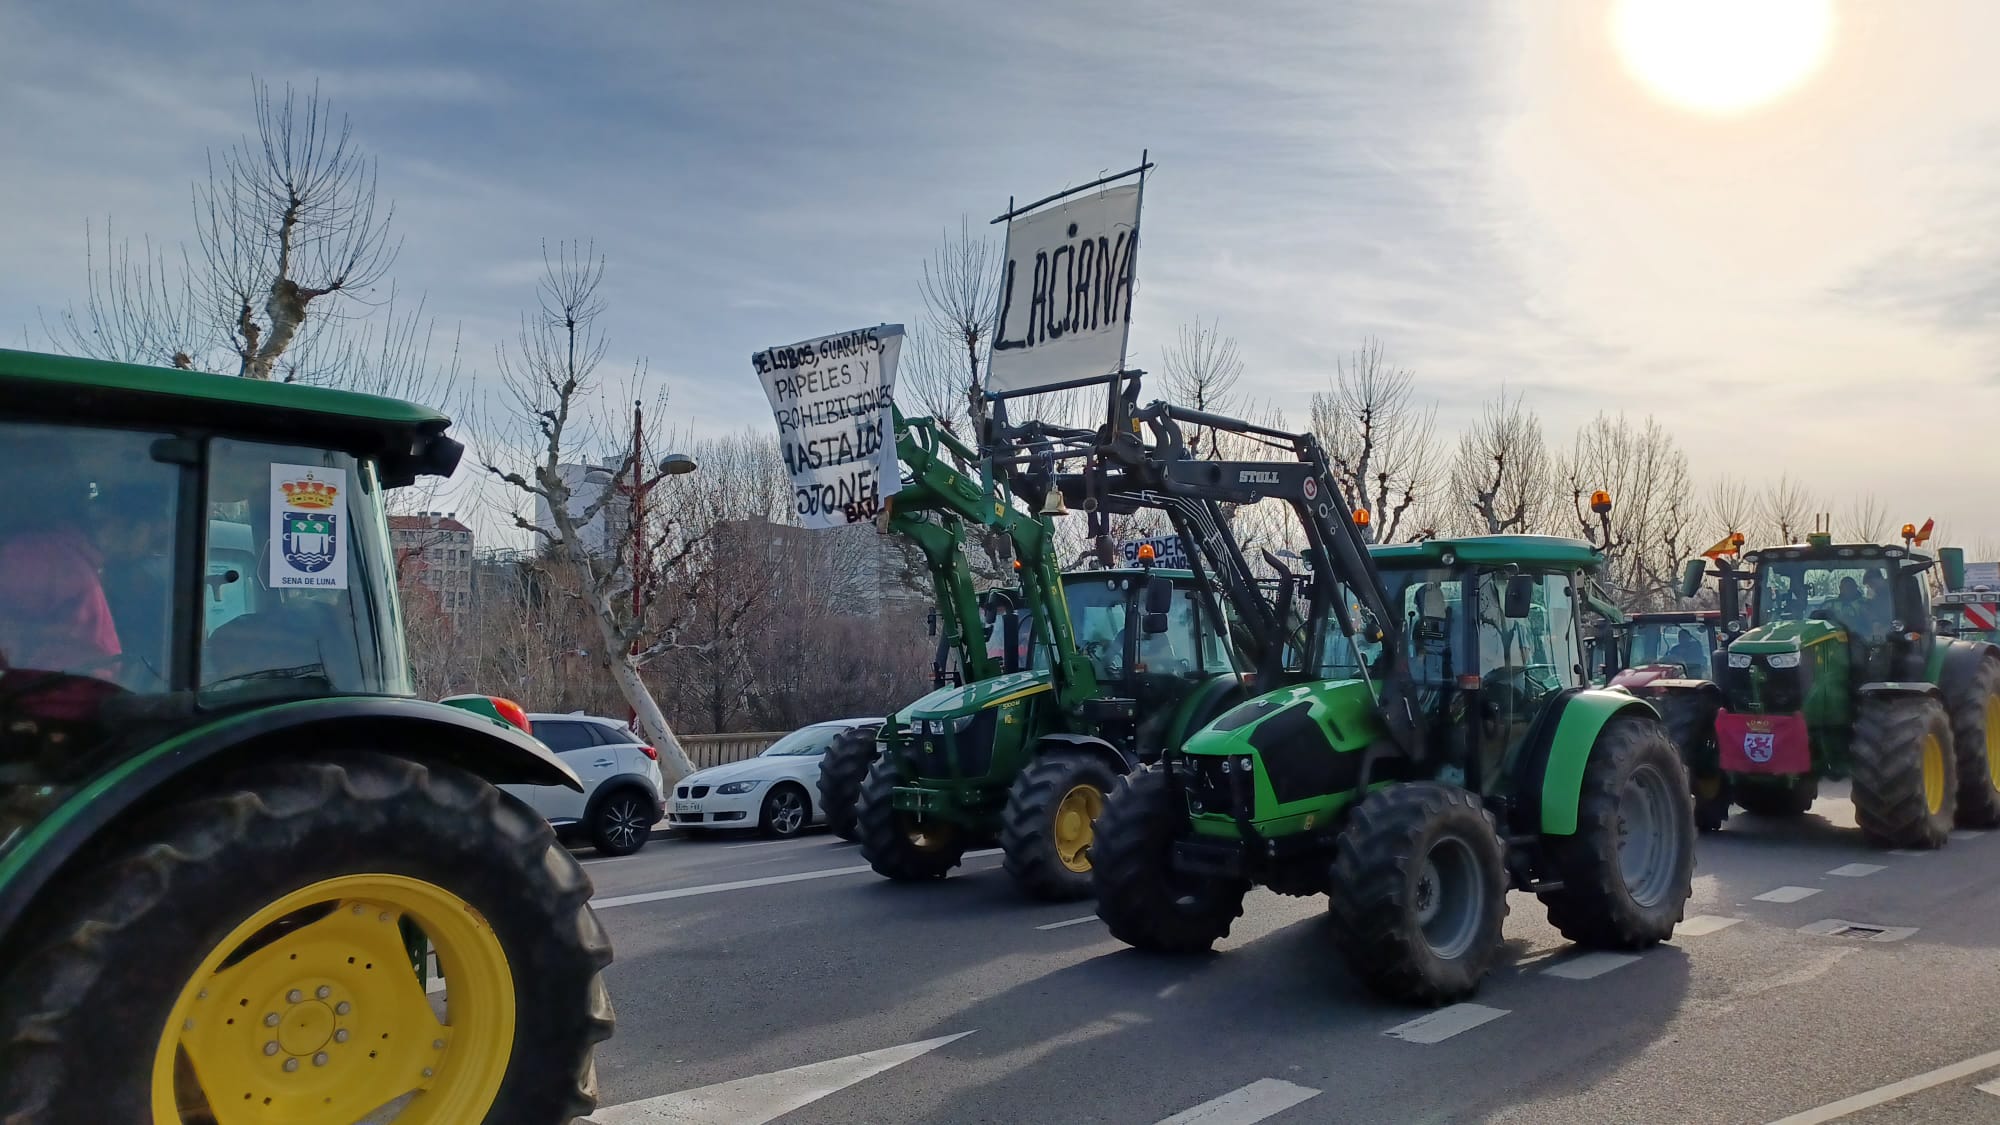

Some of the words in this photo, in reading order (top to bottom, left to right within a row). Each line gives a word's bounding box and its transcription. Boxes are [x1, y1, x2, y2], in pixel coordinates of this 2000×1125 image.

[769, 344, 820, 370] LOBOS,
[819, 327, 885, 360] GUARDAS,
[775, 364, 852, 402] PAPELES
[859, 361, 869, 384] Y
[775, 384, 894, 434] ROHIBICIONES
[784, 432, 854, 475] HASTA
[1239, 470, 1280, 484] STOLL
[282, 577, 303, 585] SENA
[304, 577, 315, 585] DE
[316, 577, 336, 586] LUNA
